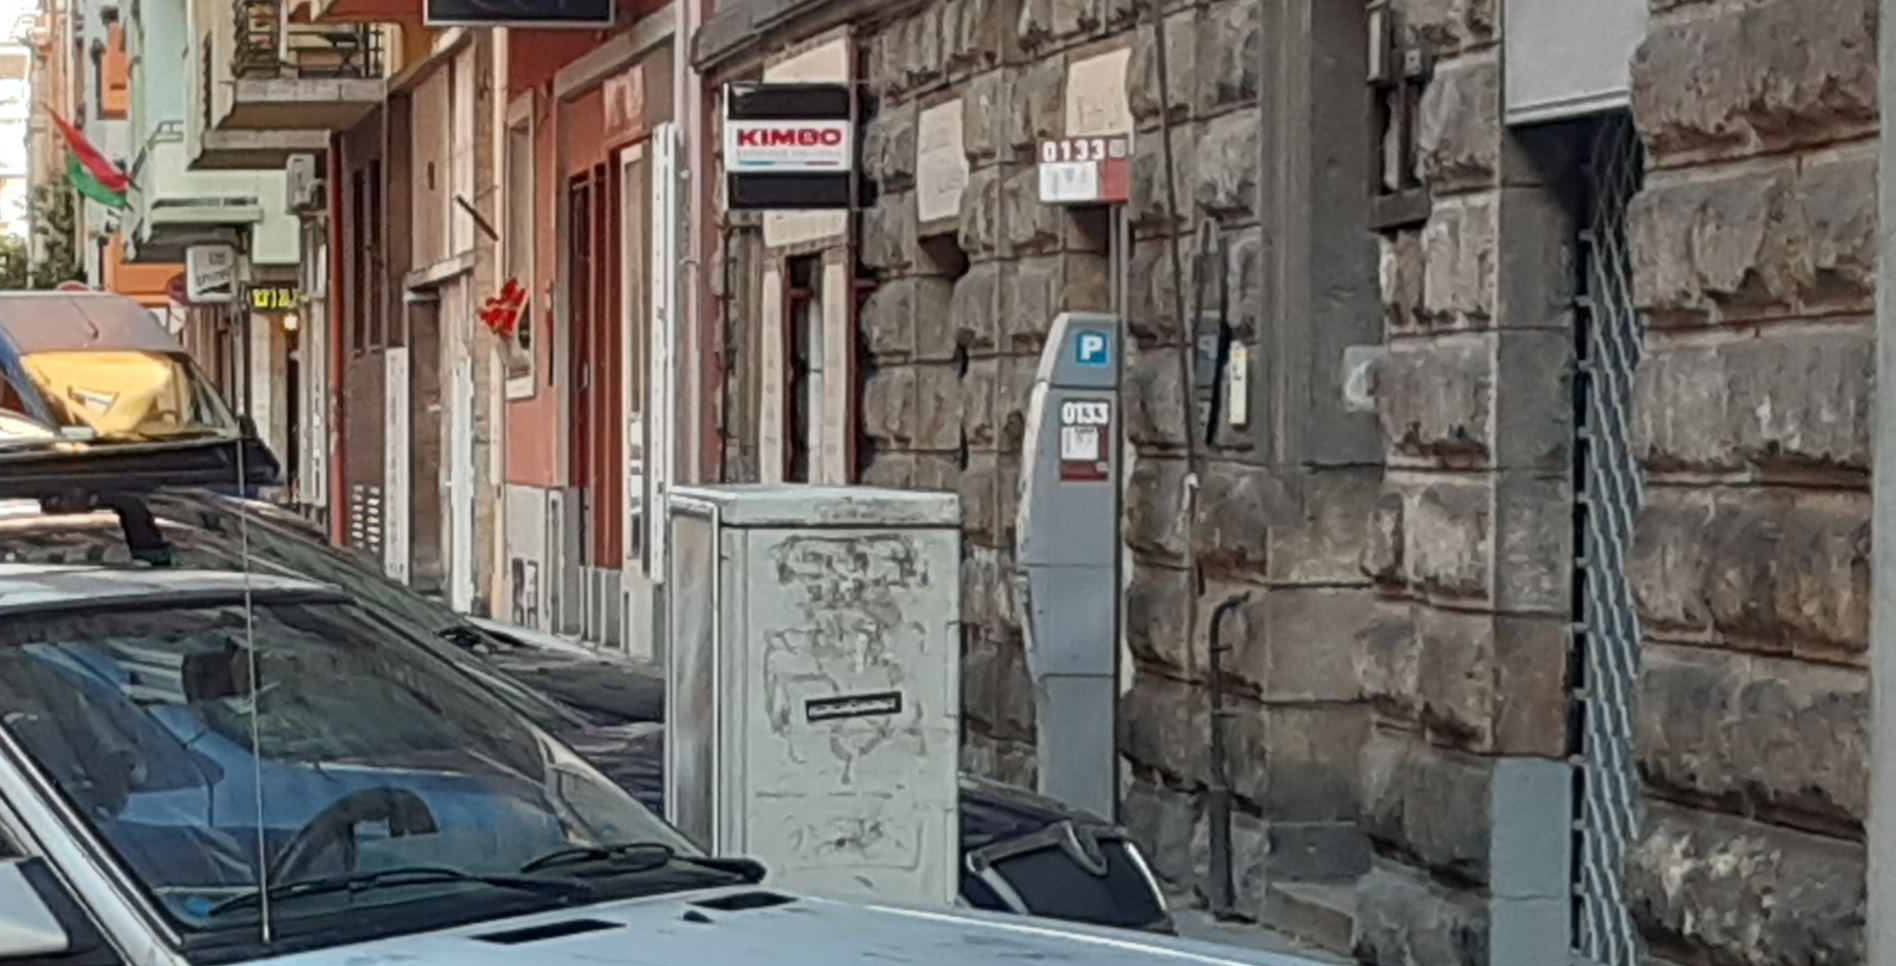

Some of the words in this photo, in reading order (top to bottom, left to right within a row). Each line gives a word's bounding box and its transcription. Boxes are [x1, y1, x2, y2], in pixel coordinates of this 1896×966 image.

[737, 128, 842, 147] KIMBO
[1042, 138, 1105, 162] 0133
[1080, 335, 1103, 361] P
